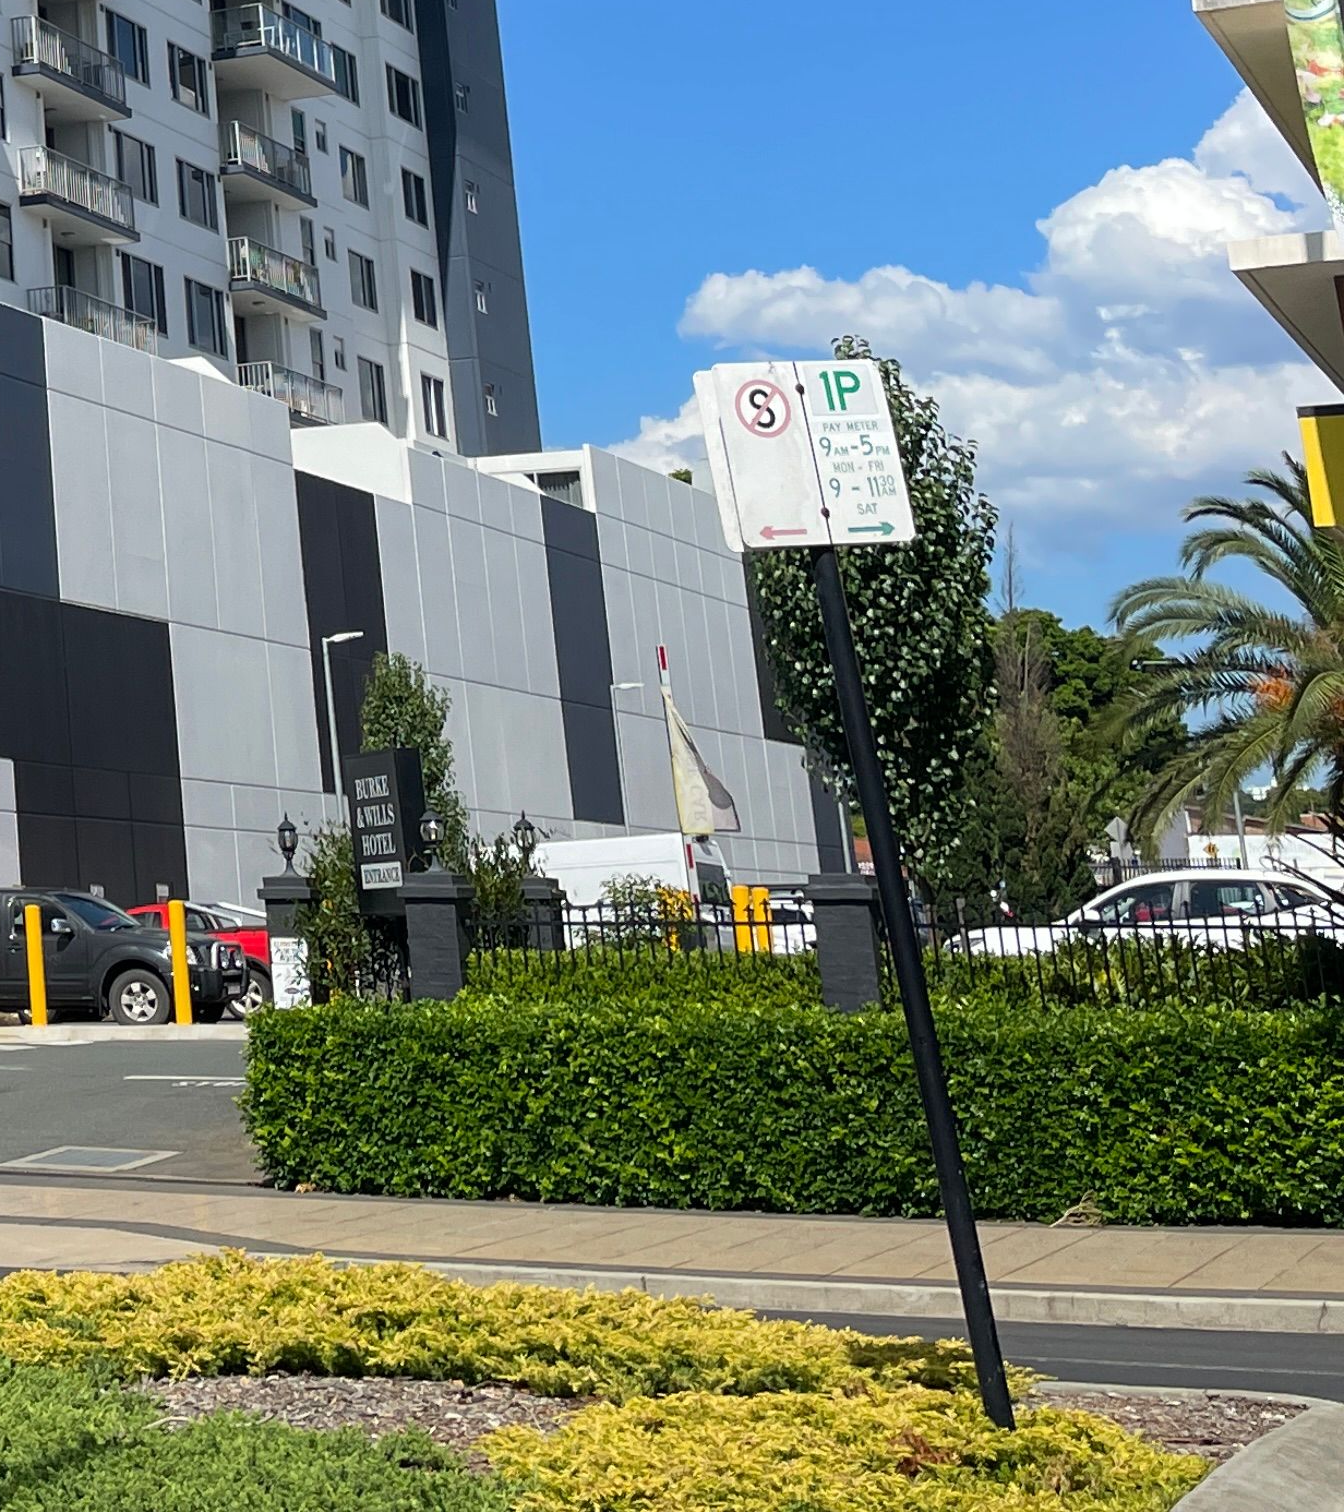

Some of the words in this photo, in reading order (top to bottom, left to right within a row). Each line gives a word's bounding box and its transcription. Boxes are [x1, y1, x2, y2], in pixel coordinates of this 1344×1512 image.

[819, 370, 861, 412] 1P
[822, 422, 841, 432] PAY
[846, 421, 879, 431] METER
[832, 461, 855, 473] MON
[868, 460, 885, 472] FRI
[857, 502, 878, 515] SAT
[355, 775, 390, 800] BURKE
[356, 807, 365, 828] &
[364, 803, 395, 827] WILLS
[361, 832, 396, 856] HOTEL
[363, 867, 400, 884] ENTRANCE
